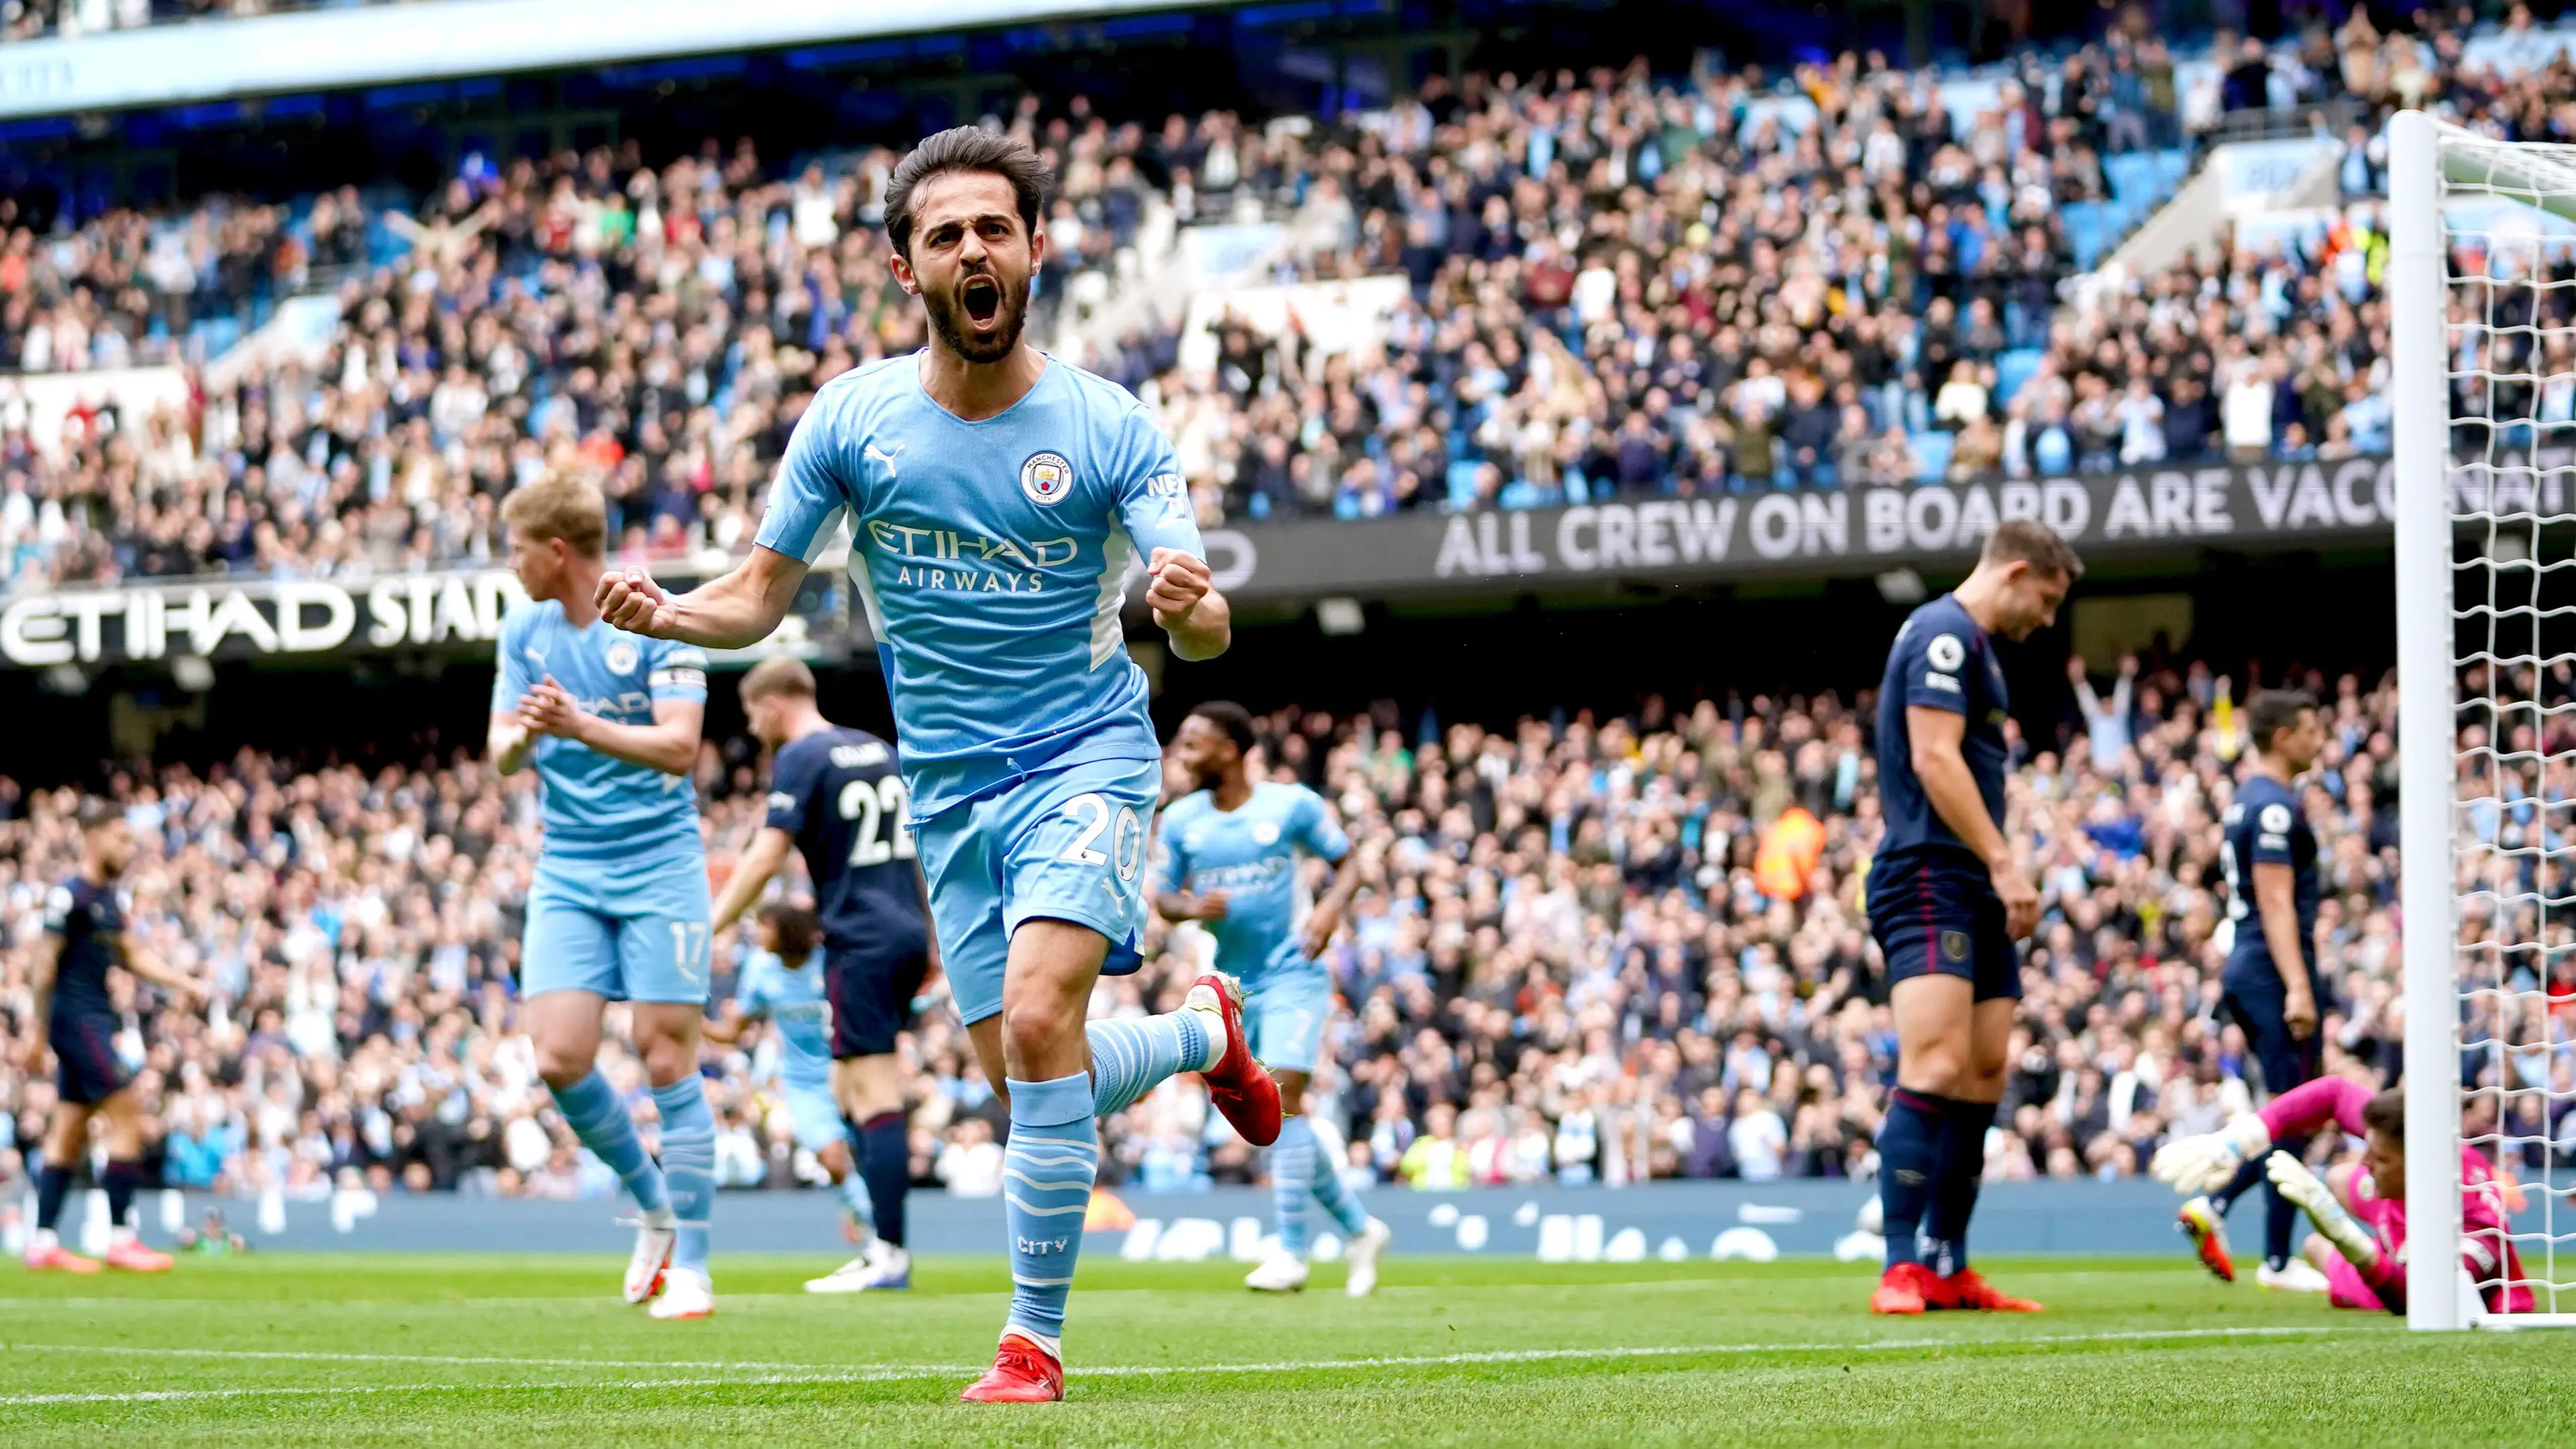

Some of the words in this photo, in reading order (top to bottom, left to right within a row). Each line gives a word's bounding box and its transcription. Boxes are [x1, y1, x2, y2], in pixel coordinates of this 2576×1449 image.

[1027, 455, 1070, 474] MANCHESTER
[867, 519, 1078, 568] ETIHAD
[1435, 511, 1545, 578] ALL
[1556, 497, 1739, 570] CREW
[1749, 491, 1849, 559] ON
[1865, 478, 2091, 553] BOARD
[2104, 470, 2235, 539] ARE
[898, 566, 1042, 593] AIRWAYS
[1, 582, 356, 665] ETIHAD
[839, 775, 916, 867] 22
[1059, 792, 1141, 881] 20
[669, 921, 706, 967] 17
[1017, 1236, 1068, 1254] CITY
